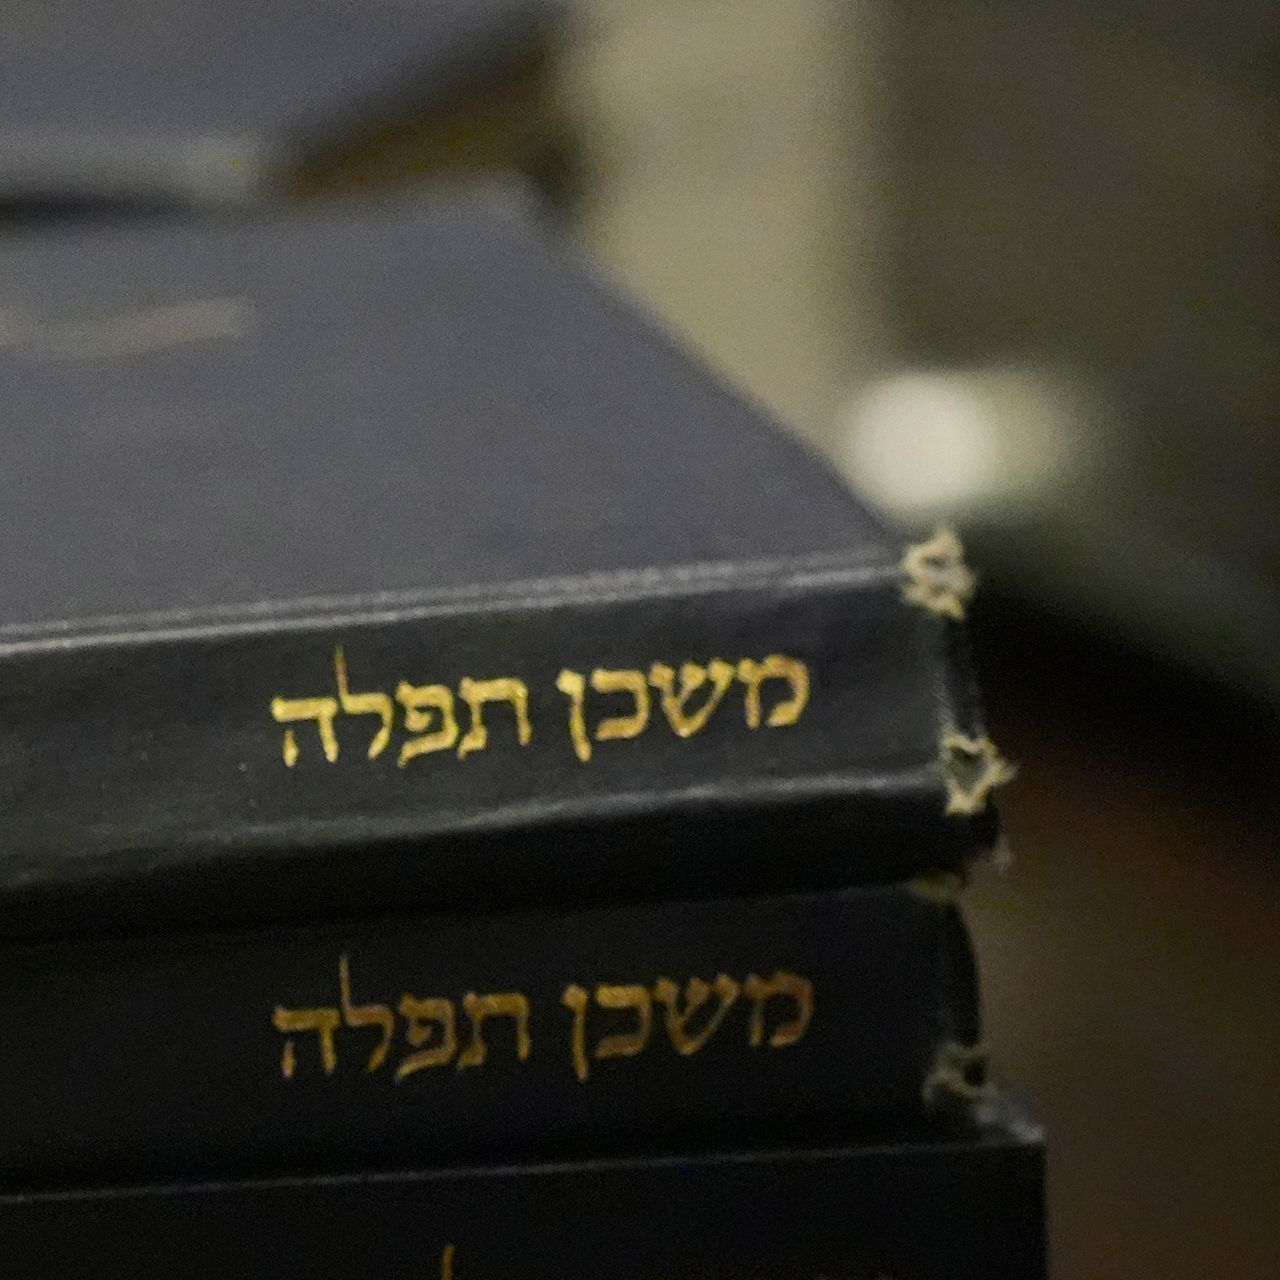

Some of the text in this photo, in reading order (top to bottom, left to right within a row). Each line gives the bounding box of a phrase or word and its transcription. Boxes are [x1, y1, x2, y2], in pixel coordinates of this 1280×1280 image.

[270, 645, 811, 766] משכן תפלה
[271, 954, 815, 1083] משכן תפלה
